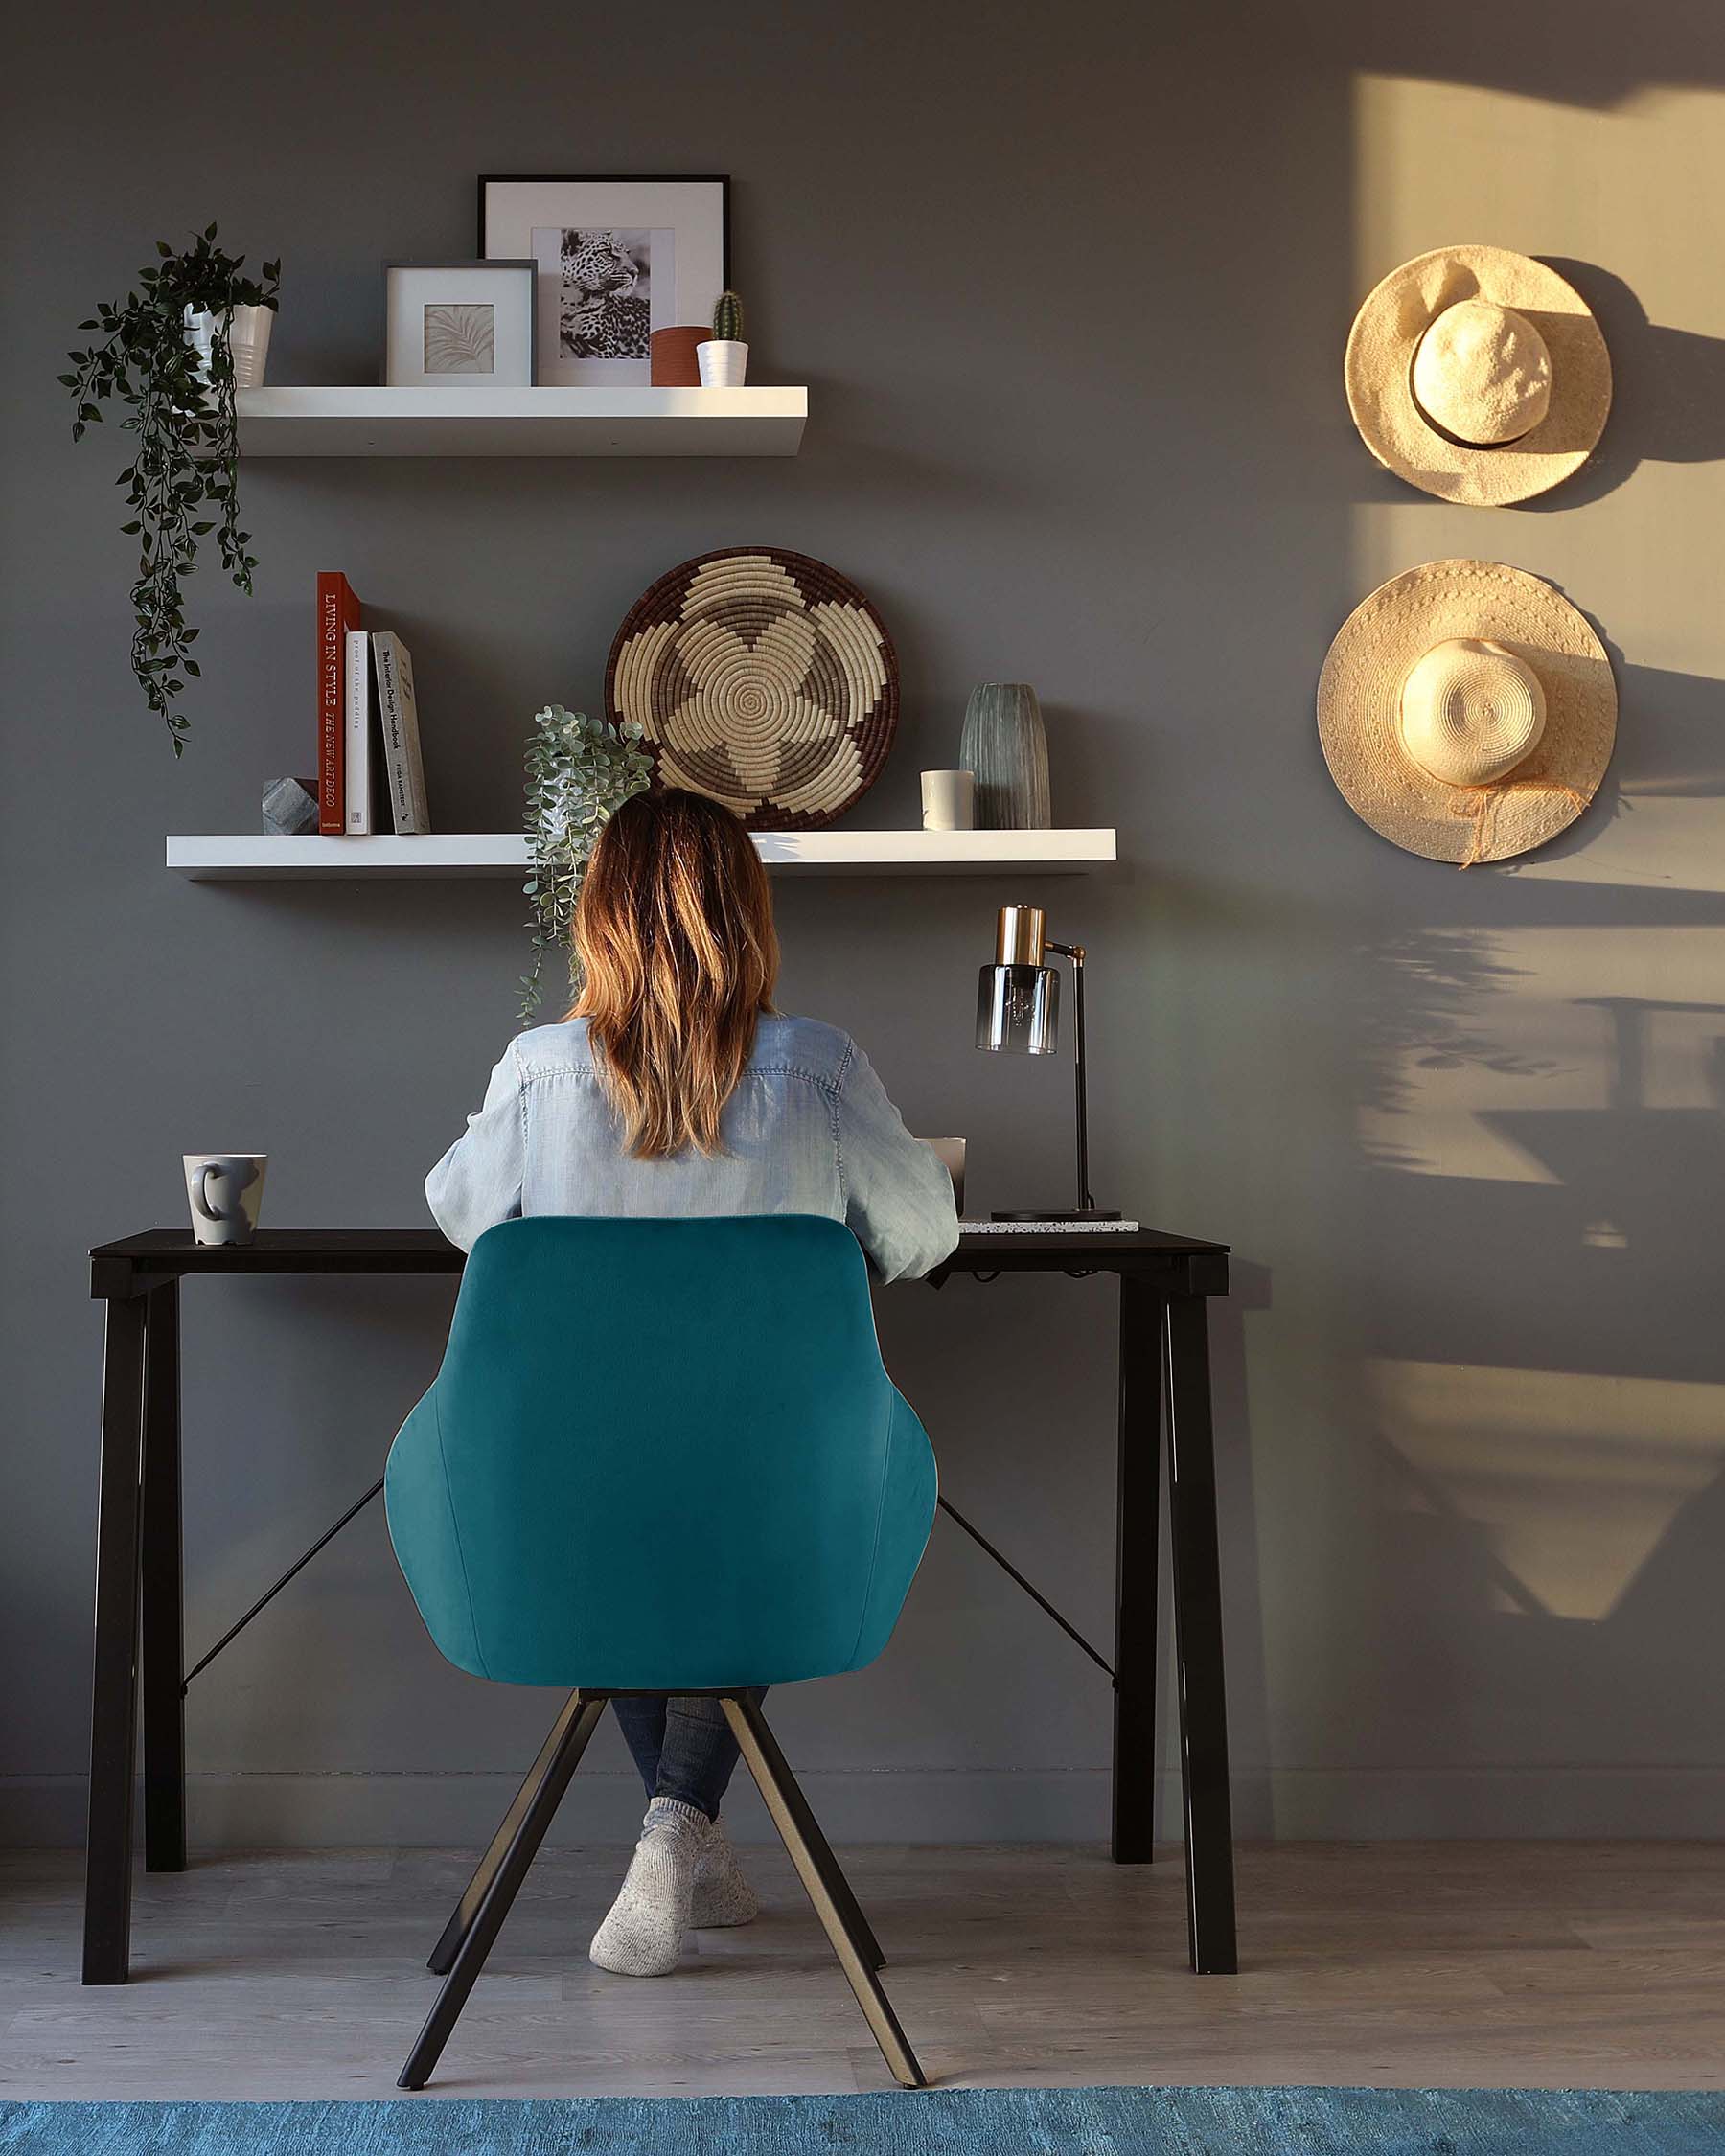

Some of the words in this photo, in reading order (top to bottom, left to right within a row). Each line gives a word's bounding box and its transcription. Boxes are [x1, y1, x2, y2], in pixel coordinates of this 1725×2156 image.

[325, 593, 336, 642] LIVING
[325, 645, 336, 661] IN
[382, 650, 391, 663] The
[325, 664, 336, 707] STYLE
[384, 663, 393, 689] Interior
[386, 689, 396, 714] Design
[325, 712, 335, 733] THE
[390, 714, 401, 750] Handbook
[325, 734, 335, 759] NEW
[325, 759, 335, 779] ART
[325, 779, 335, 807] DECO
